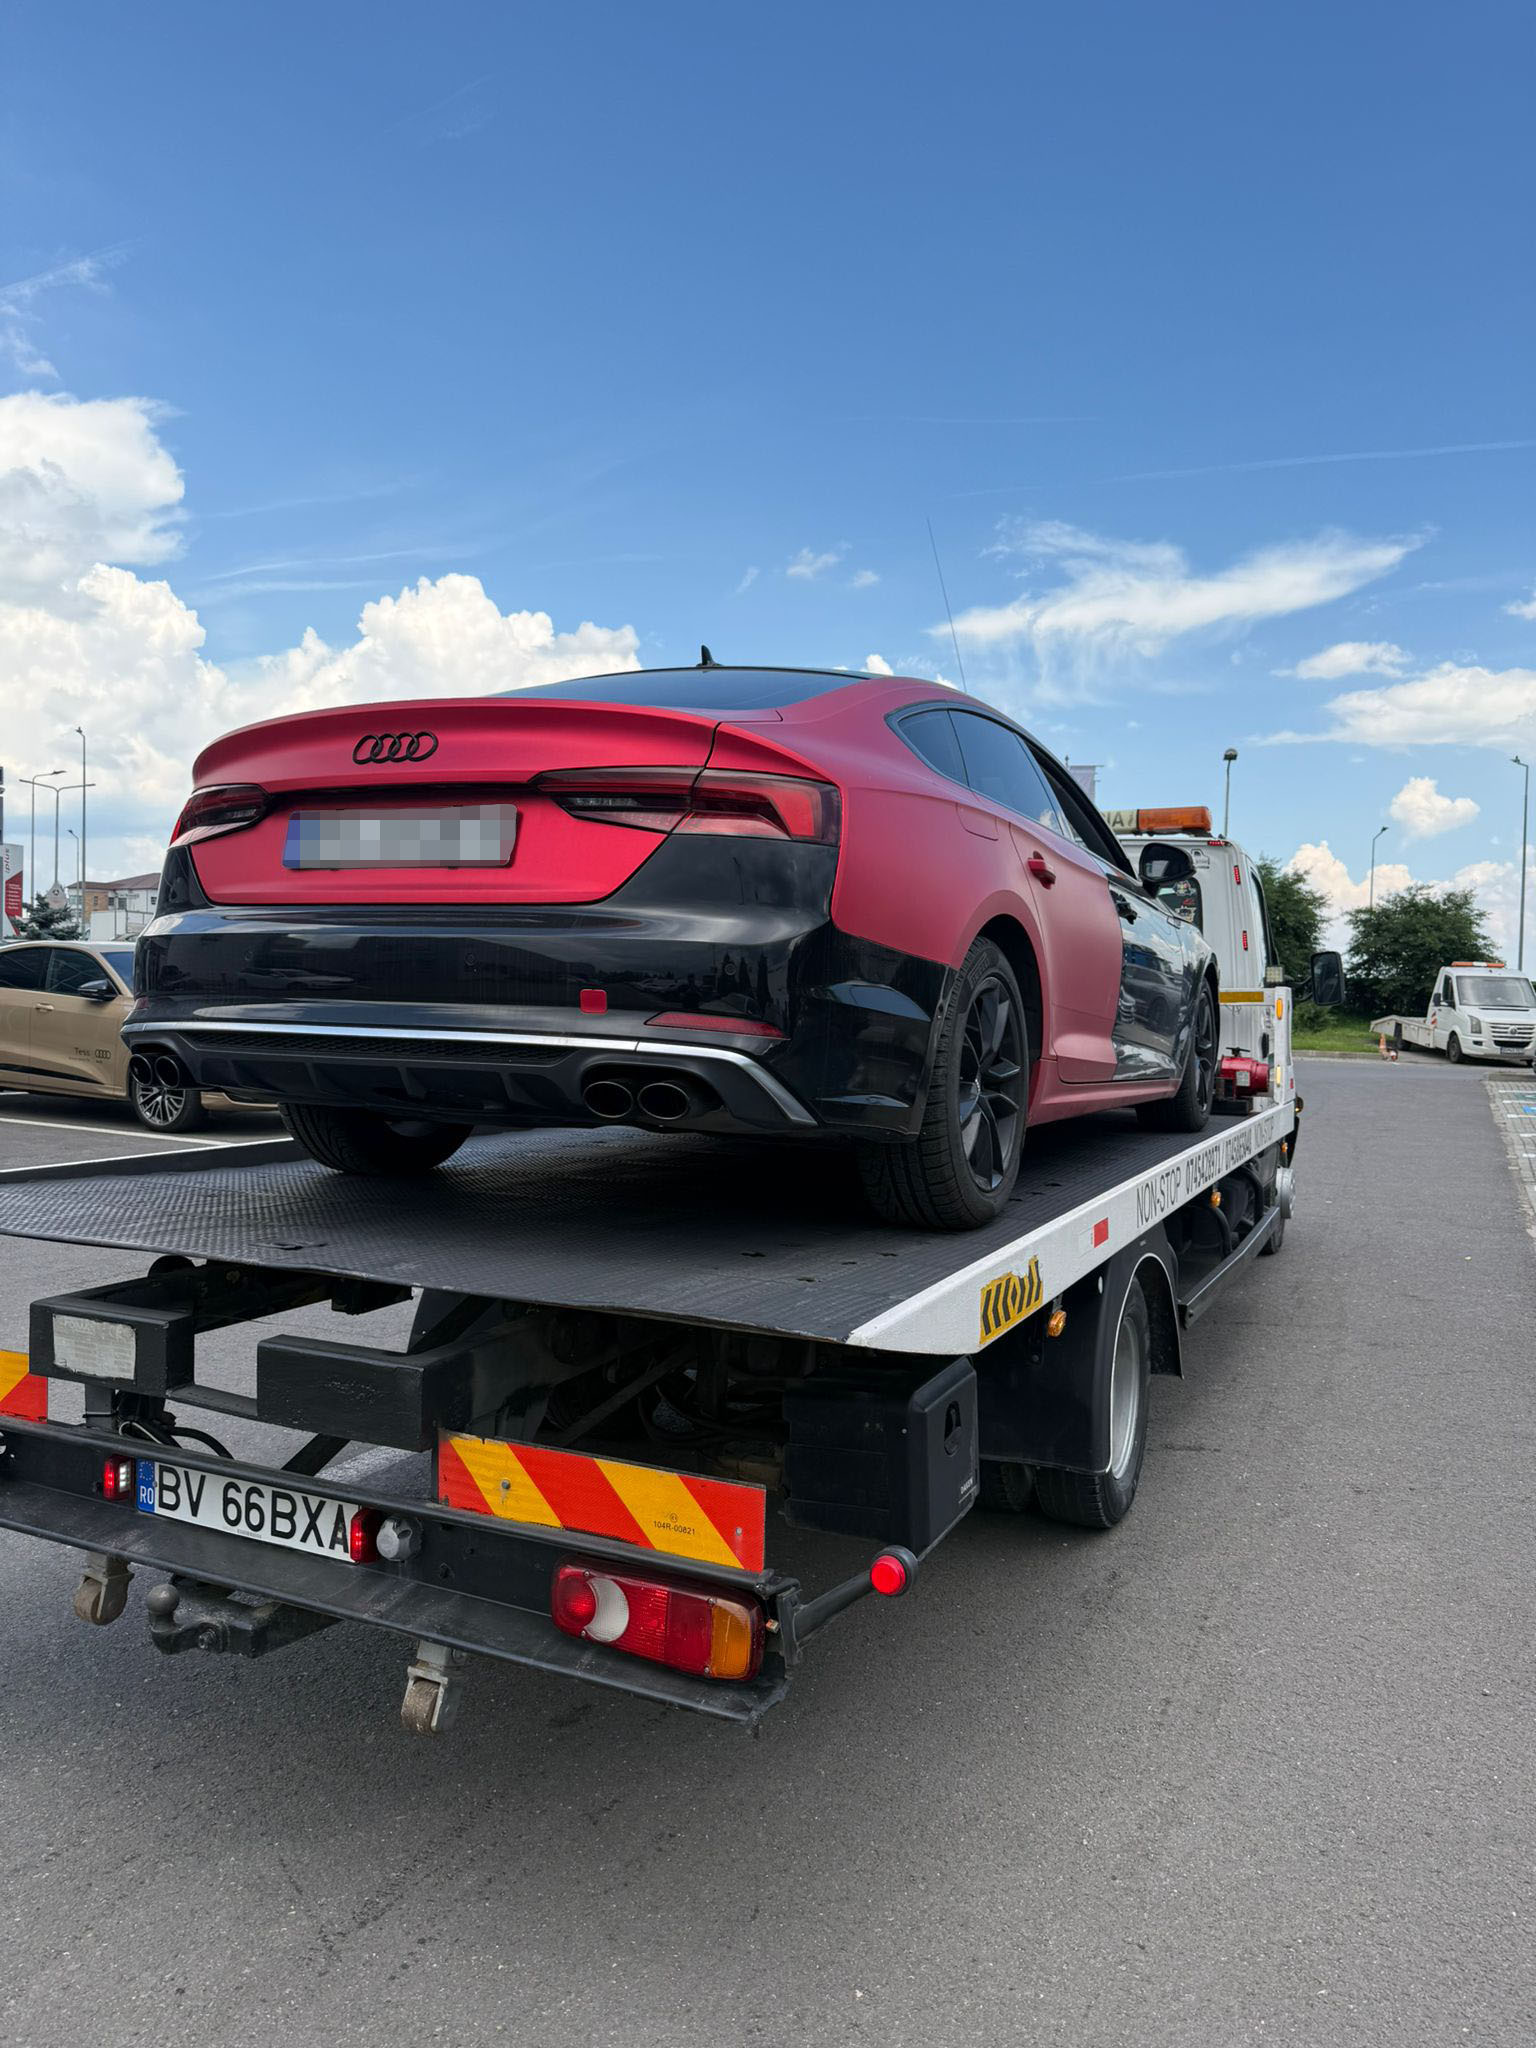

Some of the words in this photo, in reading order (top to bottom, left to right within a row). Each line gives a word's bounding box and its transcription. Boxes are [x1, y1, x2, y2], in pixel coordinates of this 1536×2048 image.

[1136, 1166, 1181, 1229] NON-STOP
[139, 1485, 154, 1505] RO
[158, 1464, 206, 1518] BV
[653, 1520, 695, 1535] 104R-00821
